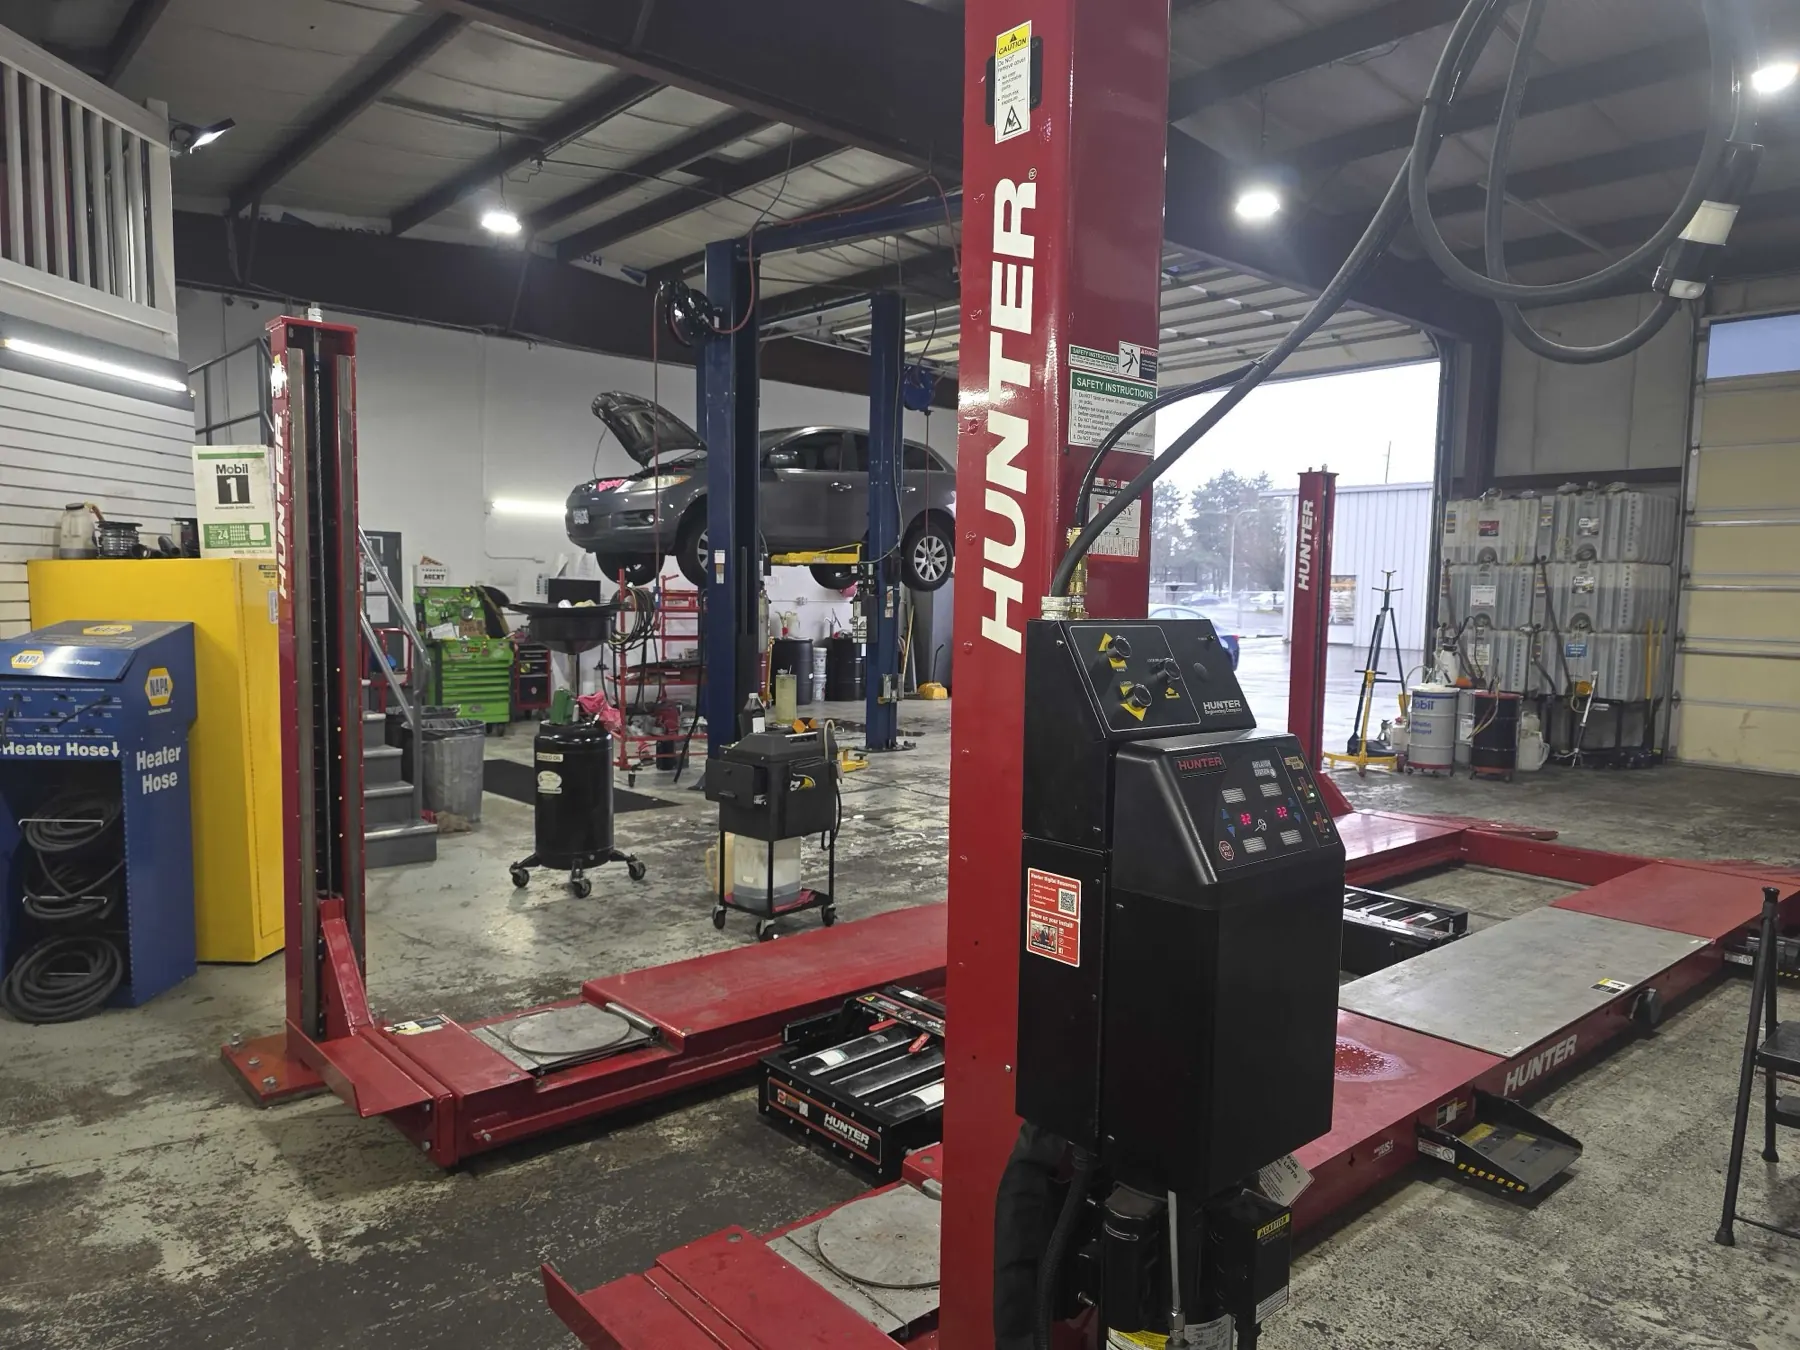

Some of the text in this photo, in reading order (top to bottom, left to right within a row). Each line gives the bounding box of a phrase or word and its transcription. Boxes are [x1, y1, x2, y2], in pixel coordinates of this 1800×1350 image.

[998, 38, 1026, 54] CAUTION
[1076, 378, 1154, 400] SAFETY INSTRUCTIONS
[981, 177, 1038, 654] HUNTER
[216, 464, 248, 474] Mobil
[226, 477, 239, 502] 1
[274, 412, 286, 600] HUNTER
[218, 530, 229, 539] 24
[1298, 500, 1313, 590] HUNTER
[150, 678, 168, 696] NAPA
[1203, 700, 1240, 709] HUNTER
[66, 742, 109, 756] Hose
[136, 746, 181, 771] Heater
[1178, 756, 1222, 770] HUNTER
[142, 772, 178, 794] Hose
[1504, 1034, 1577, 1096] HUNTER
[825, 1113, 869, 1144] HUNTER
